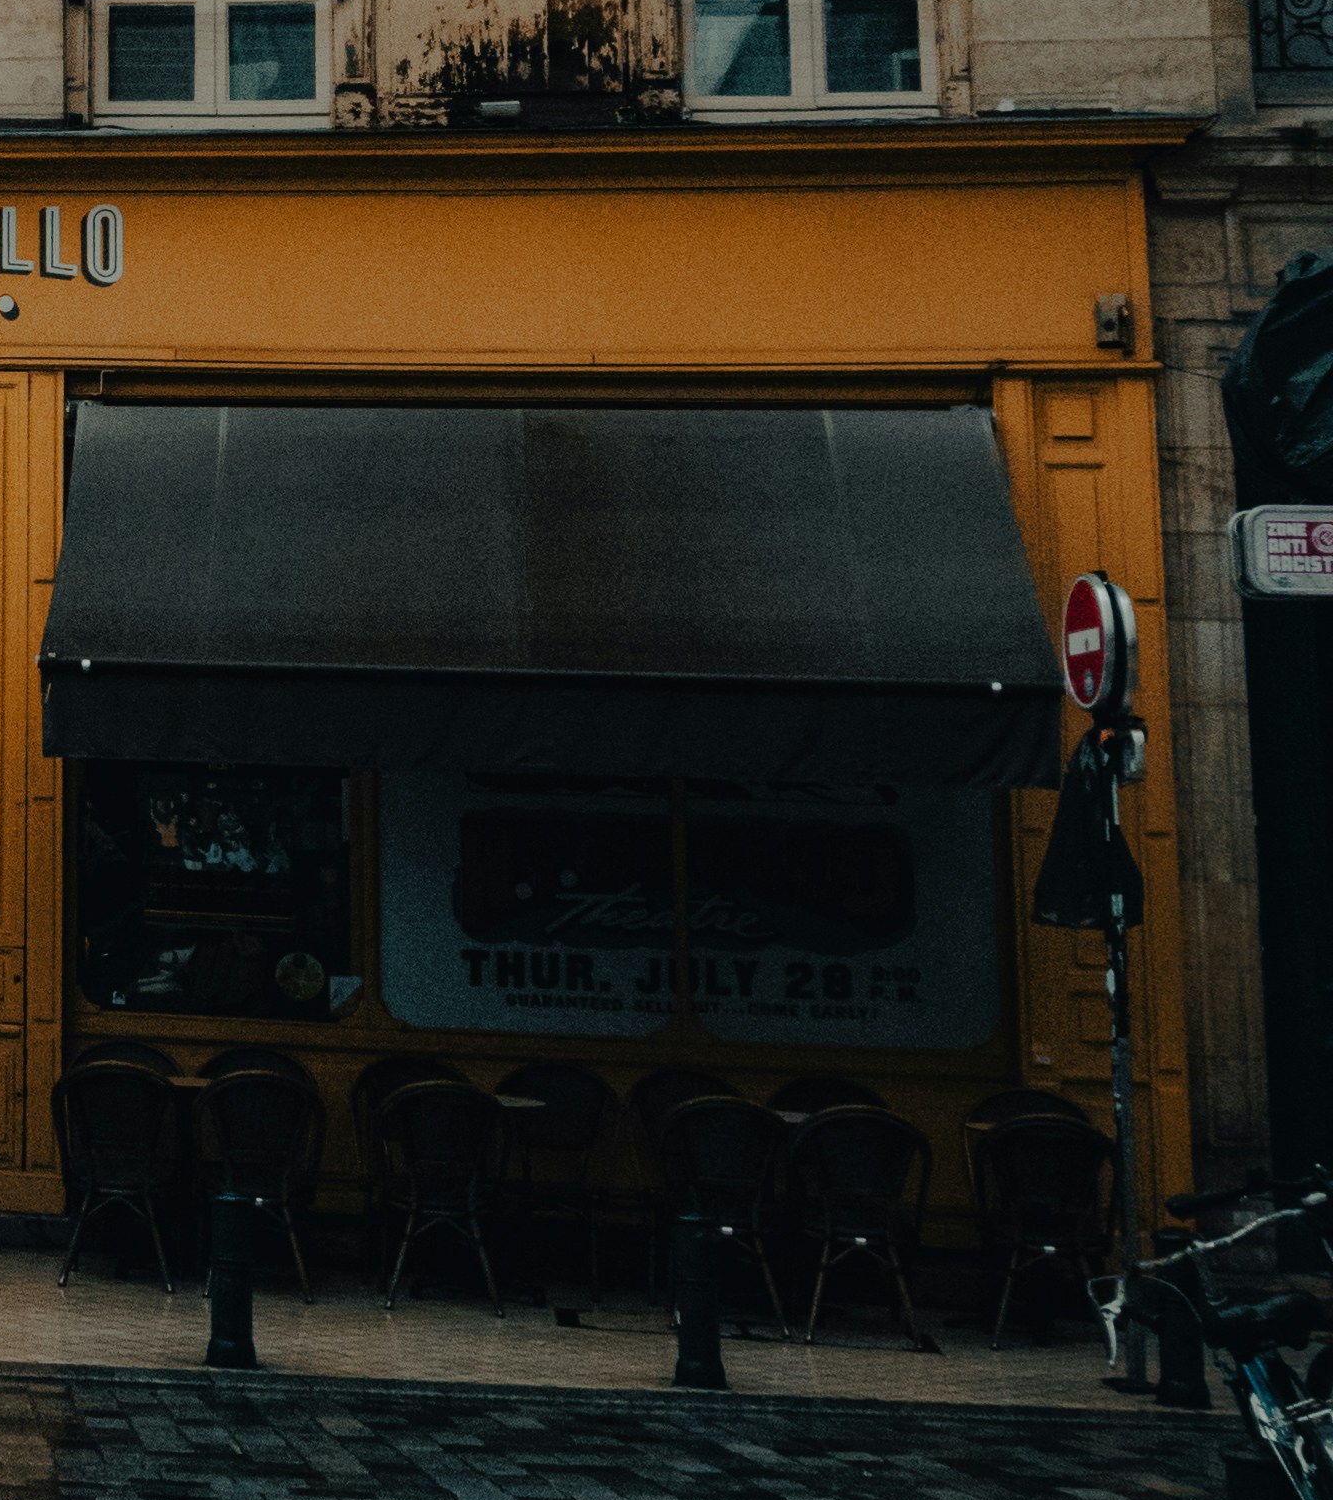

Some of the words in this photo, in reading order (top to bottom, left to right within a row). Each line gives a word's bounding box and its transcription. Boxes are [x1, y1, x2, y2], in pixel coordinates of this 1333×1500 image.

[1267, 522, 1308, 537] ZONE
[1268, 538, 1308, 554] ANTI
[462, 949, 612, 992] THUR.
[636, 956, 760, 997] JULY
[784, 962, 853, 1000] 28
